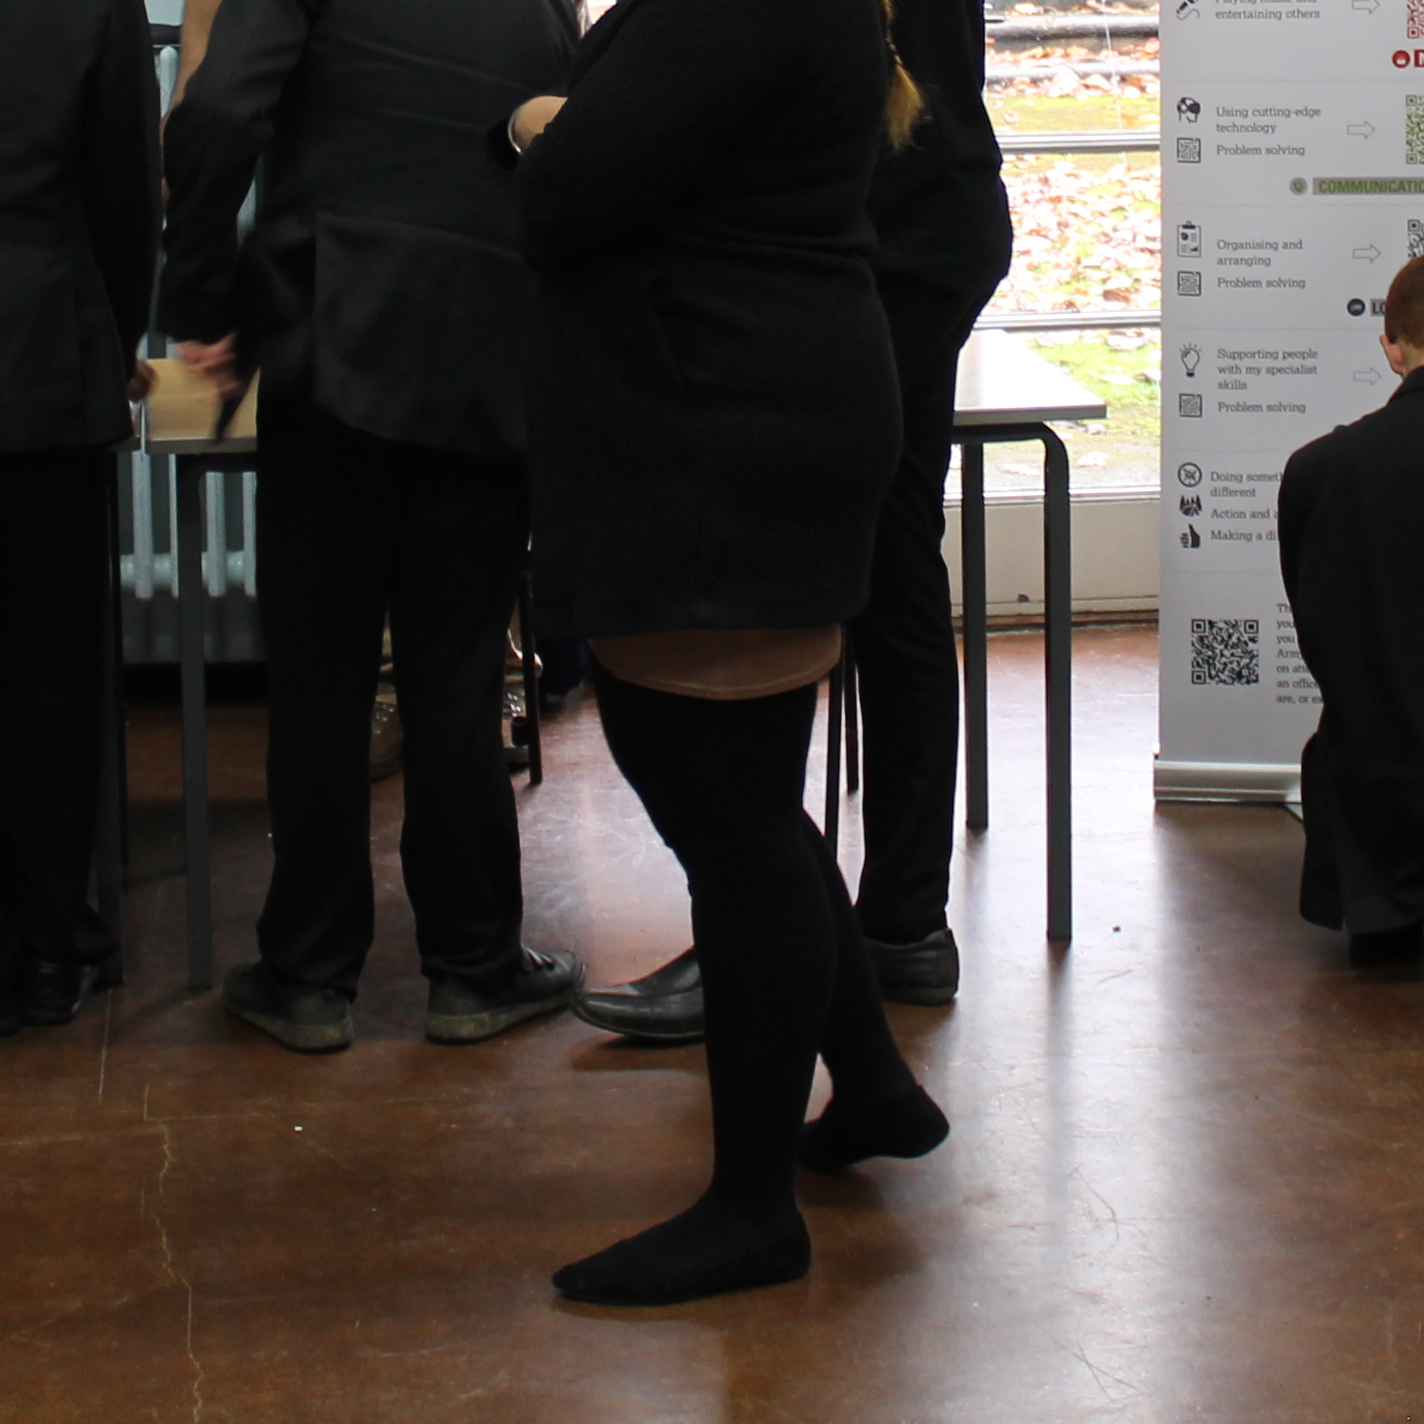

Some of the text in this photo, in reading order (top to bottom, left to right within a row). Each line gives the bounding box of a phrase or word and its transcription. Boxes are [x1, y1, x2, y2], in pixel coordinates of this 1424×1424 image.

[1215, 6, 1320, 22] entertaining others
[1216, 104, 1321, 120] Using cutting-edge
[1216, 120, 1276, 136] technology
[1216, 143, 1305, 158] Problem solving
[1216, 237, 1302, 253] Organising and
[1216, 254, 1271, 268] arranging
[1217, 276, 1306, 291] Problem solving
[1217, 347, 1318, 362] Supporting people
[1217, 362, 1317, 378] with my specialist
[1217, 378, 1247, 390] skills
[1217, 400, 1306, 415] Problem solving
[1210, 470, 1243, 485] Doing
[1210, 485, 1256, 497] different
[1210, 507, 1270, 519] Action and
[1210, 528, 1266, 544] Making a
